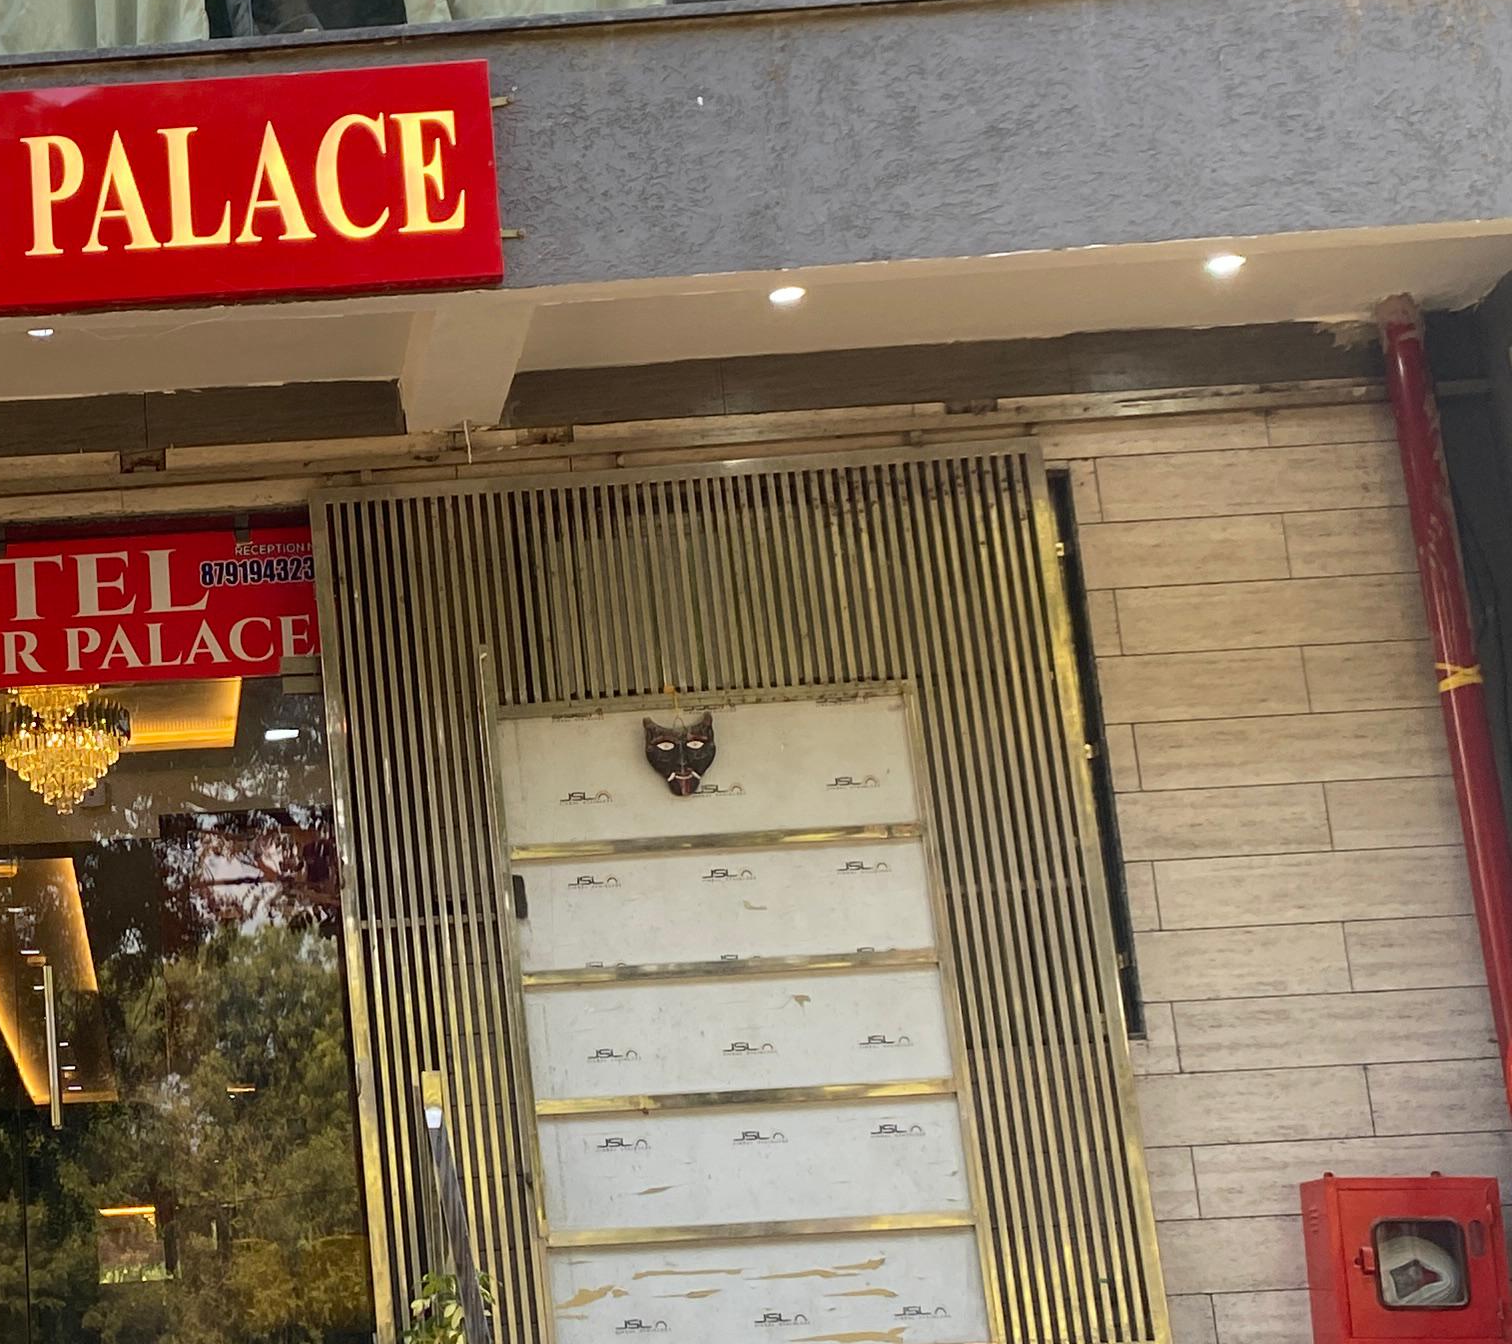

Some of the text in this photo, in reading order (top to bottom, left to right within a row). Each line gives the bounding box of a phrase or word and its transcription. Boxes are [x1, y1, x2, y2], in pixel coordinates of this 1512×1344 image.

[19, 109, 467, 256] PALACE
[234, 543, 305, 556] RECEPTION
[65, 614, 316, 672] PALACE
